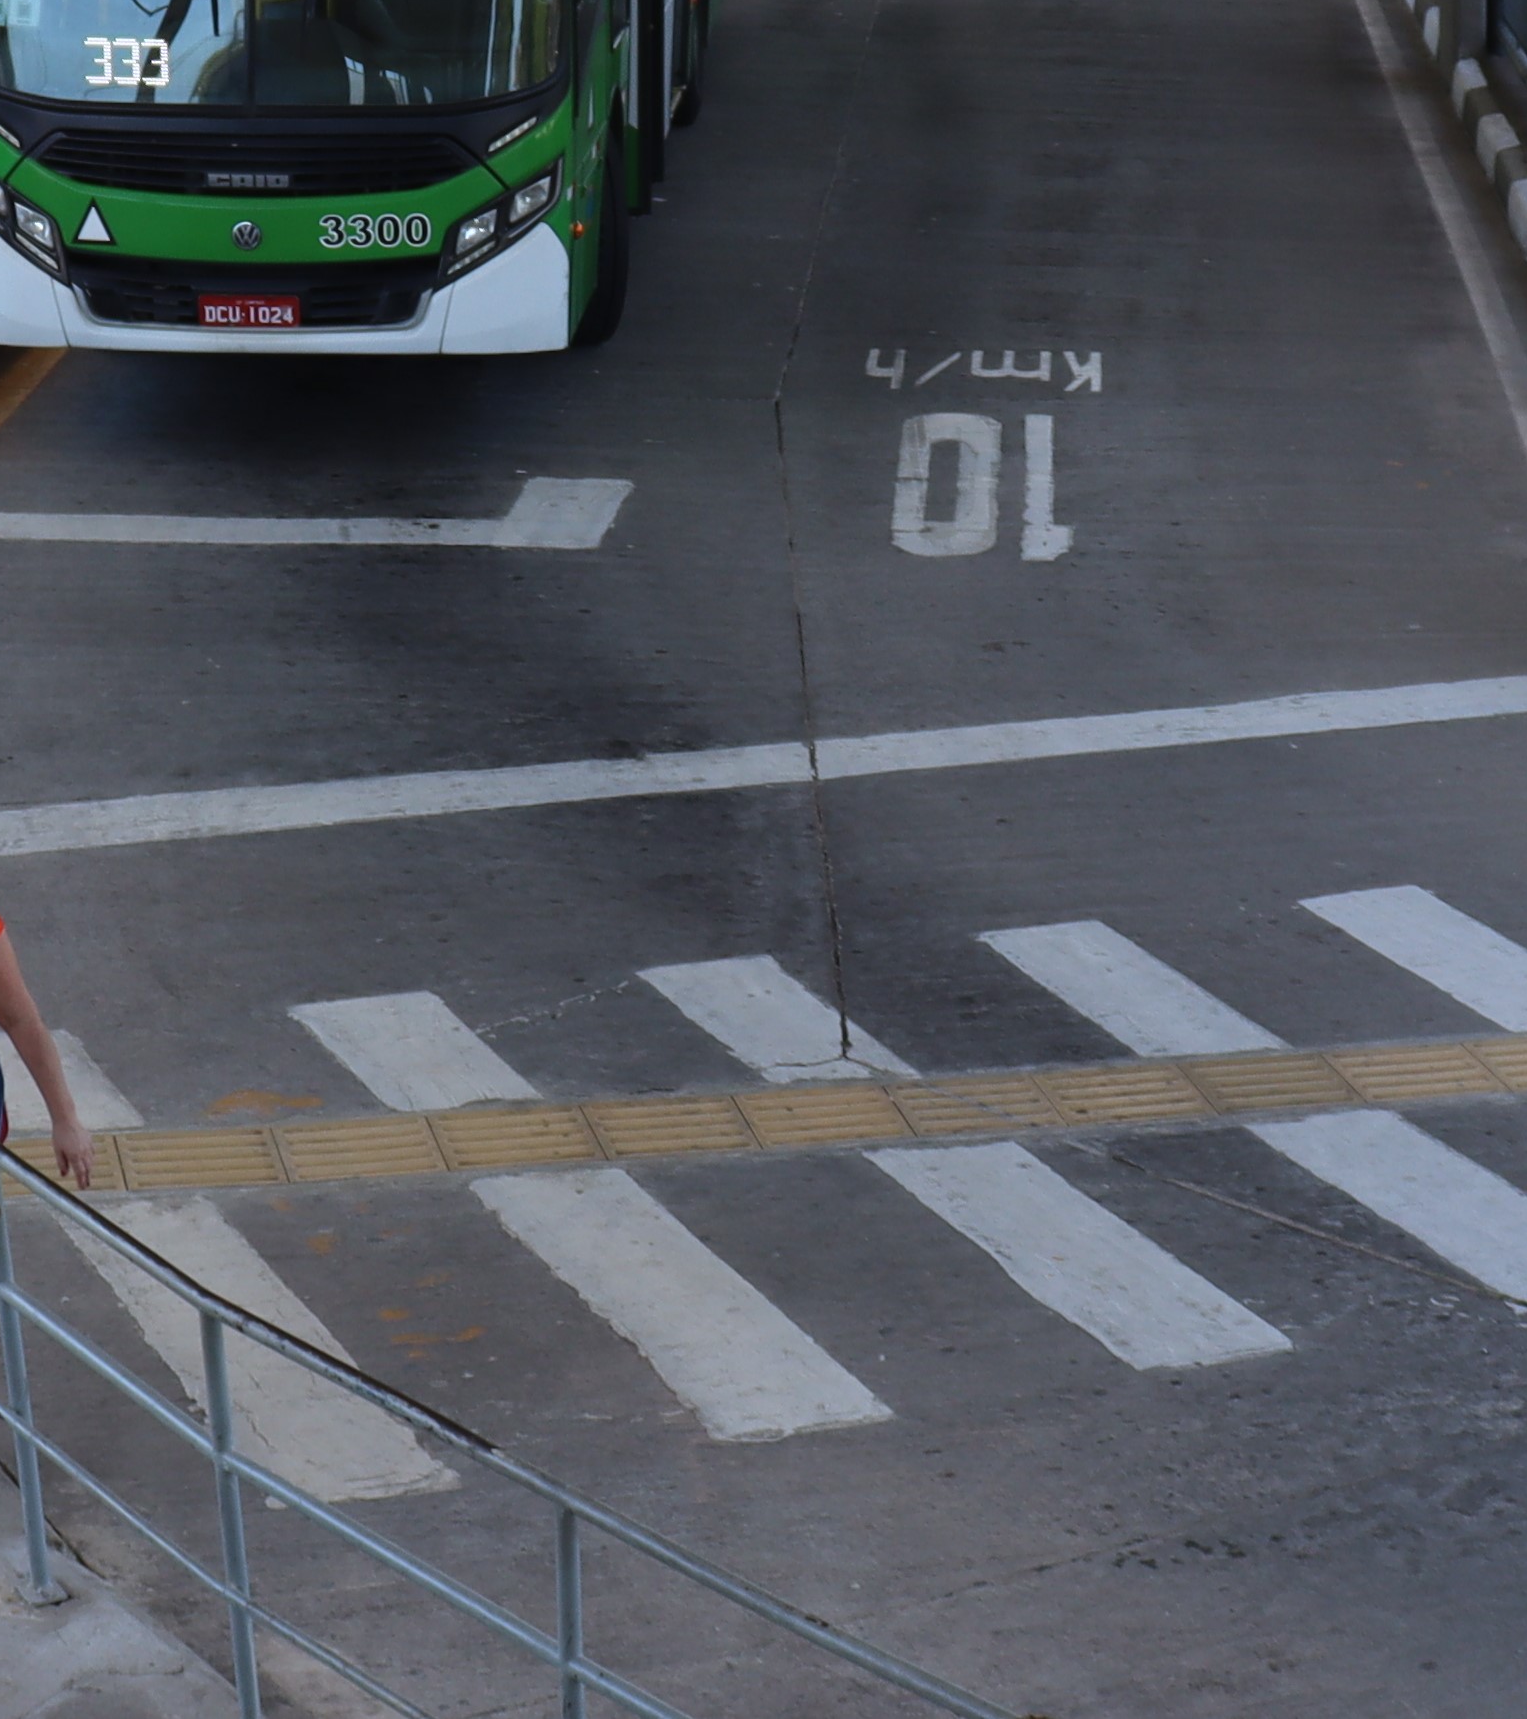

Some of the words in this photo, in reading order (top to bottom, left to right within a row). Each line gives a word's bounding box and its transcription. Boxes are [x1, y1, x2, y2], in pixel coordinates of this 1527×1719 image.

[84, 37, 170, 86] 333
[319, 213, 432, 249] 3300
[891, 413, 1074, 561] 10
